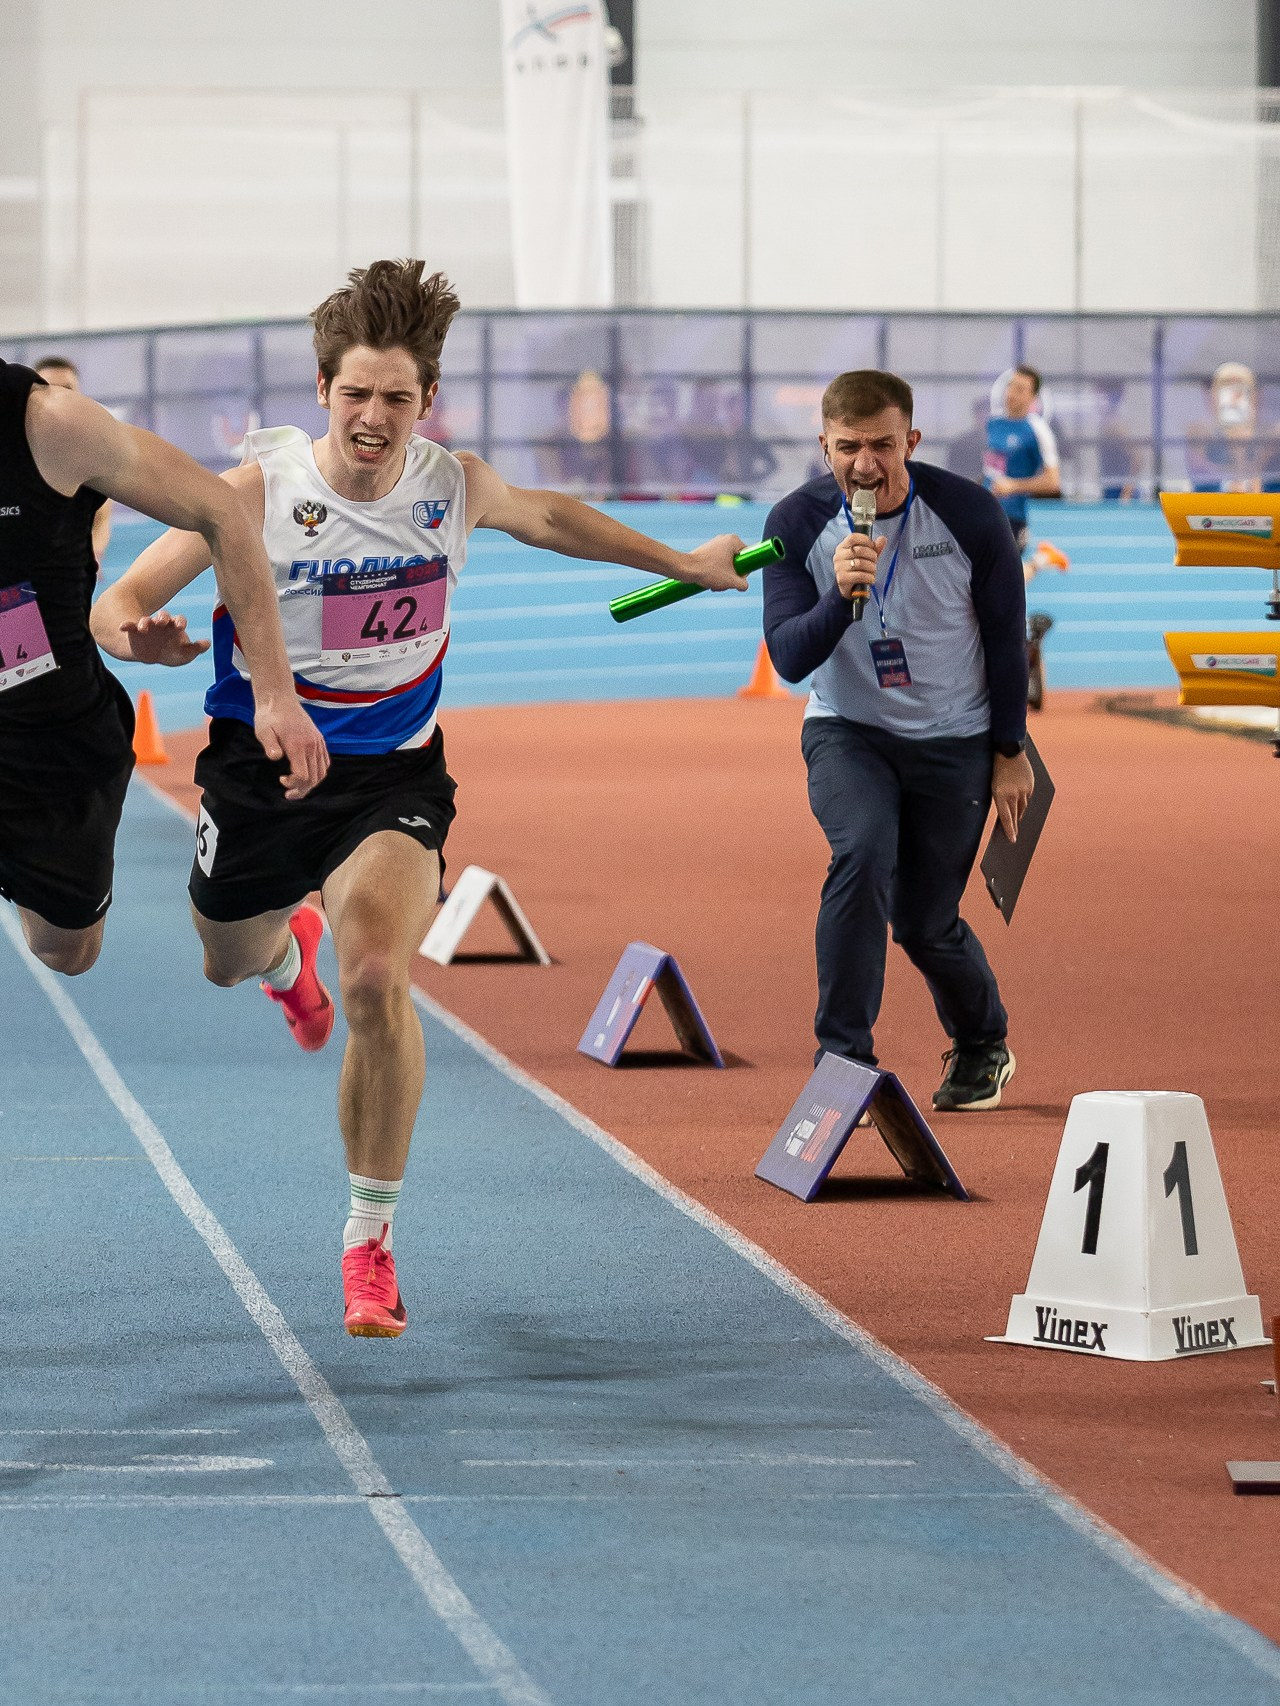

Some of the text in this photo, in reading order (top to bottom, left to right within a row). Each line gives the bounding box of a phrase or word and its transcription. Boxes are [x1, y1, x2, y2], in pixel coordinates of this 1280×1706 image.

[360, 596, 428, 642] 42 4
[15, 643, 28, 661] 4
[1073, 1141, 1110, 1256] 1
[1163, 1141, 1199, 1256] 1
[1033, 1305, 1108, 1351] Vinex
[1172, 1315, 1238, 1354] Vinex
